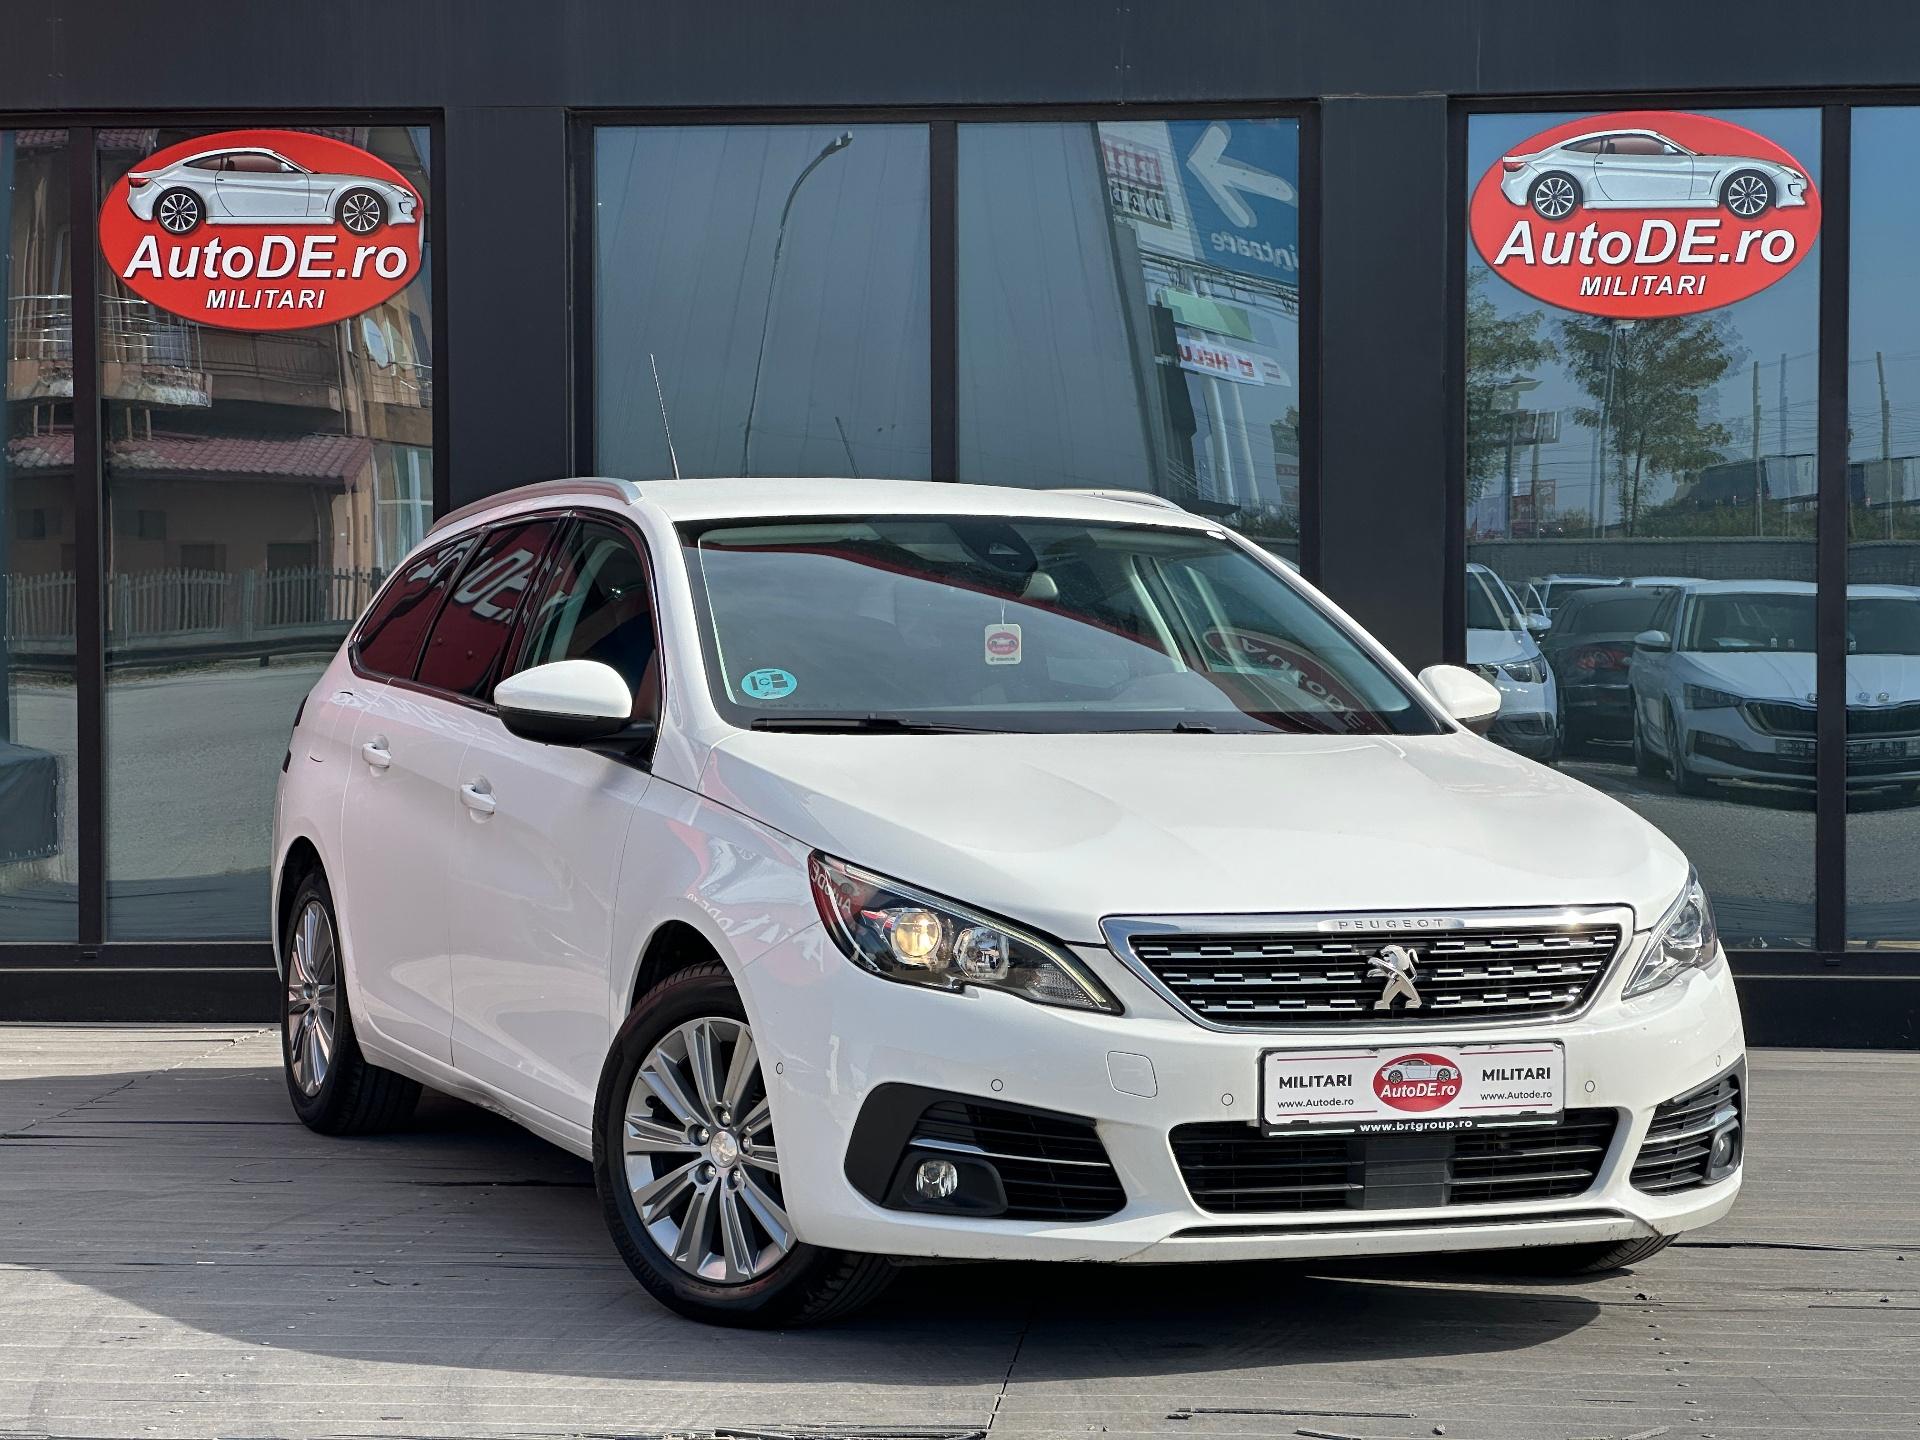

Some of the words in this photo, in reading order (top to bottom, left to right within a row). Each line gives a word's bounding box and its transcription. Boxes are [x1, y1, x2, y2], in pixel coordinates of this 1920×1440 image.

[1493, 218, 1796, 265] AutoDE.ro
[123, 235, 408, 279] AutoDE.ro
[1579, 275, 1706, 296] MILITARI
[206, 289, 326, 309] MILITARI
[1338, 918, 1444, 930] PEUGEOT
[1279, 1074, 1353, 1089] MILITARI
[1482, 1067, 1551, 1081] MILITARI
[1380, 1083, 1456, 1098] AutoDE.ro
[1480, 1090, 1553, 1100] www.Autode.ro
[1277, 1097, 1354, 1108] www.Autode.ro
[1360, 1120, 1473, 1132] www.brtgroup.ro
